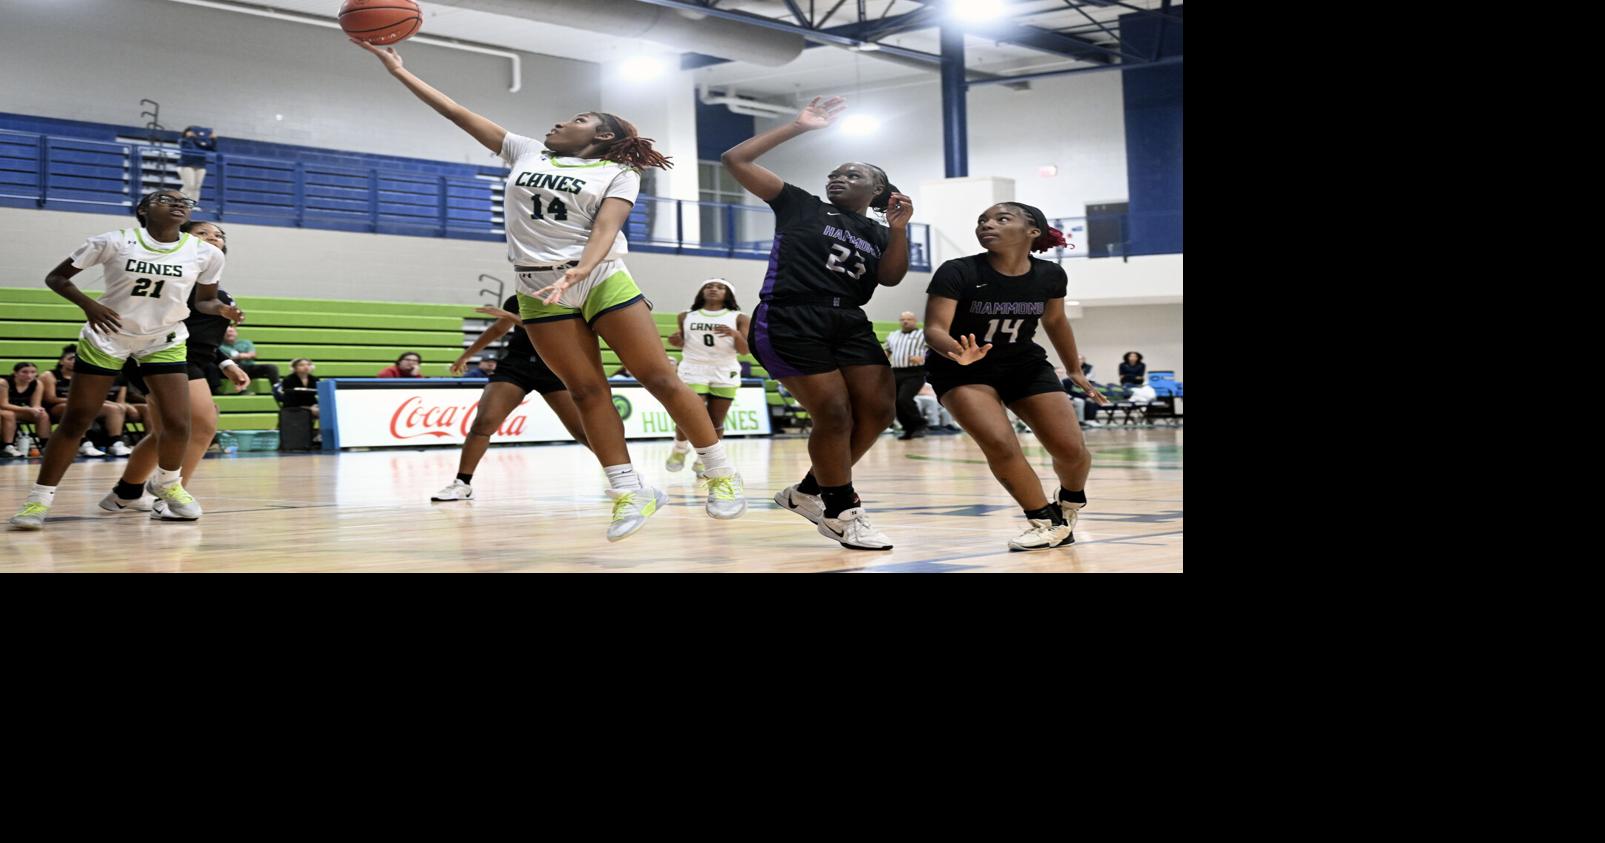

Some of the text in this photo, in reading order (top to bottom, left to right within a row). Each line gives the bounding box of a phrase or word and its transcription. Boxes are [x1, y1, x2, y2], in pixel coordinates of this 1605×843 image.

[514, 171, 587, 195] CANES
[530, 193, 568, 221] 14
[125, 258, 183, 278] CANES
[130, 277, 165, 299] 21
[703, 333, 715, 348] 0
[983, 318, 1025, 343] 14
